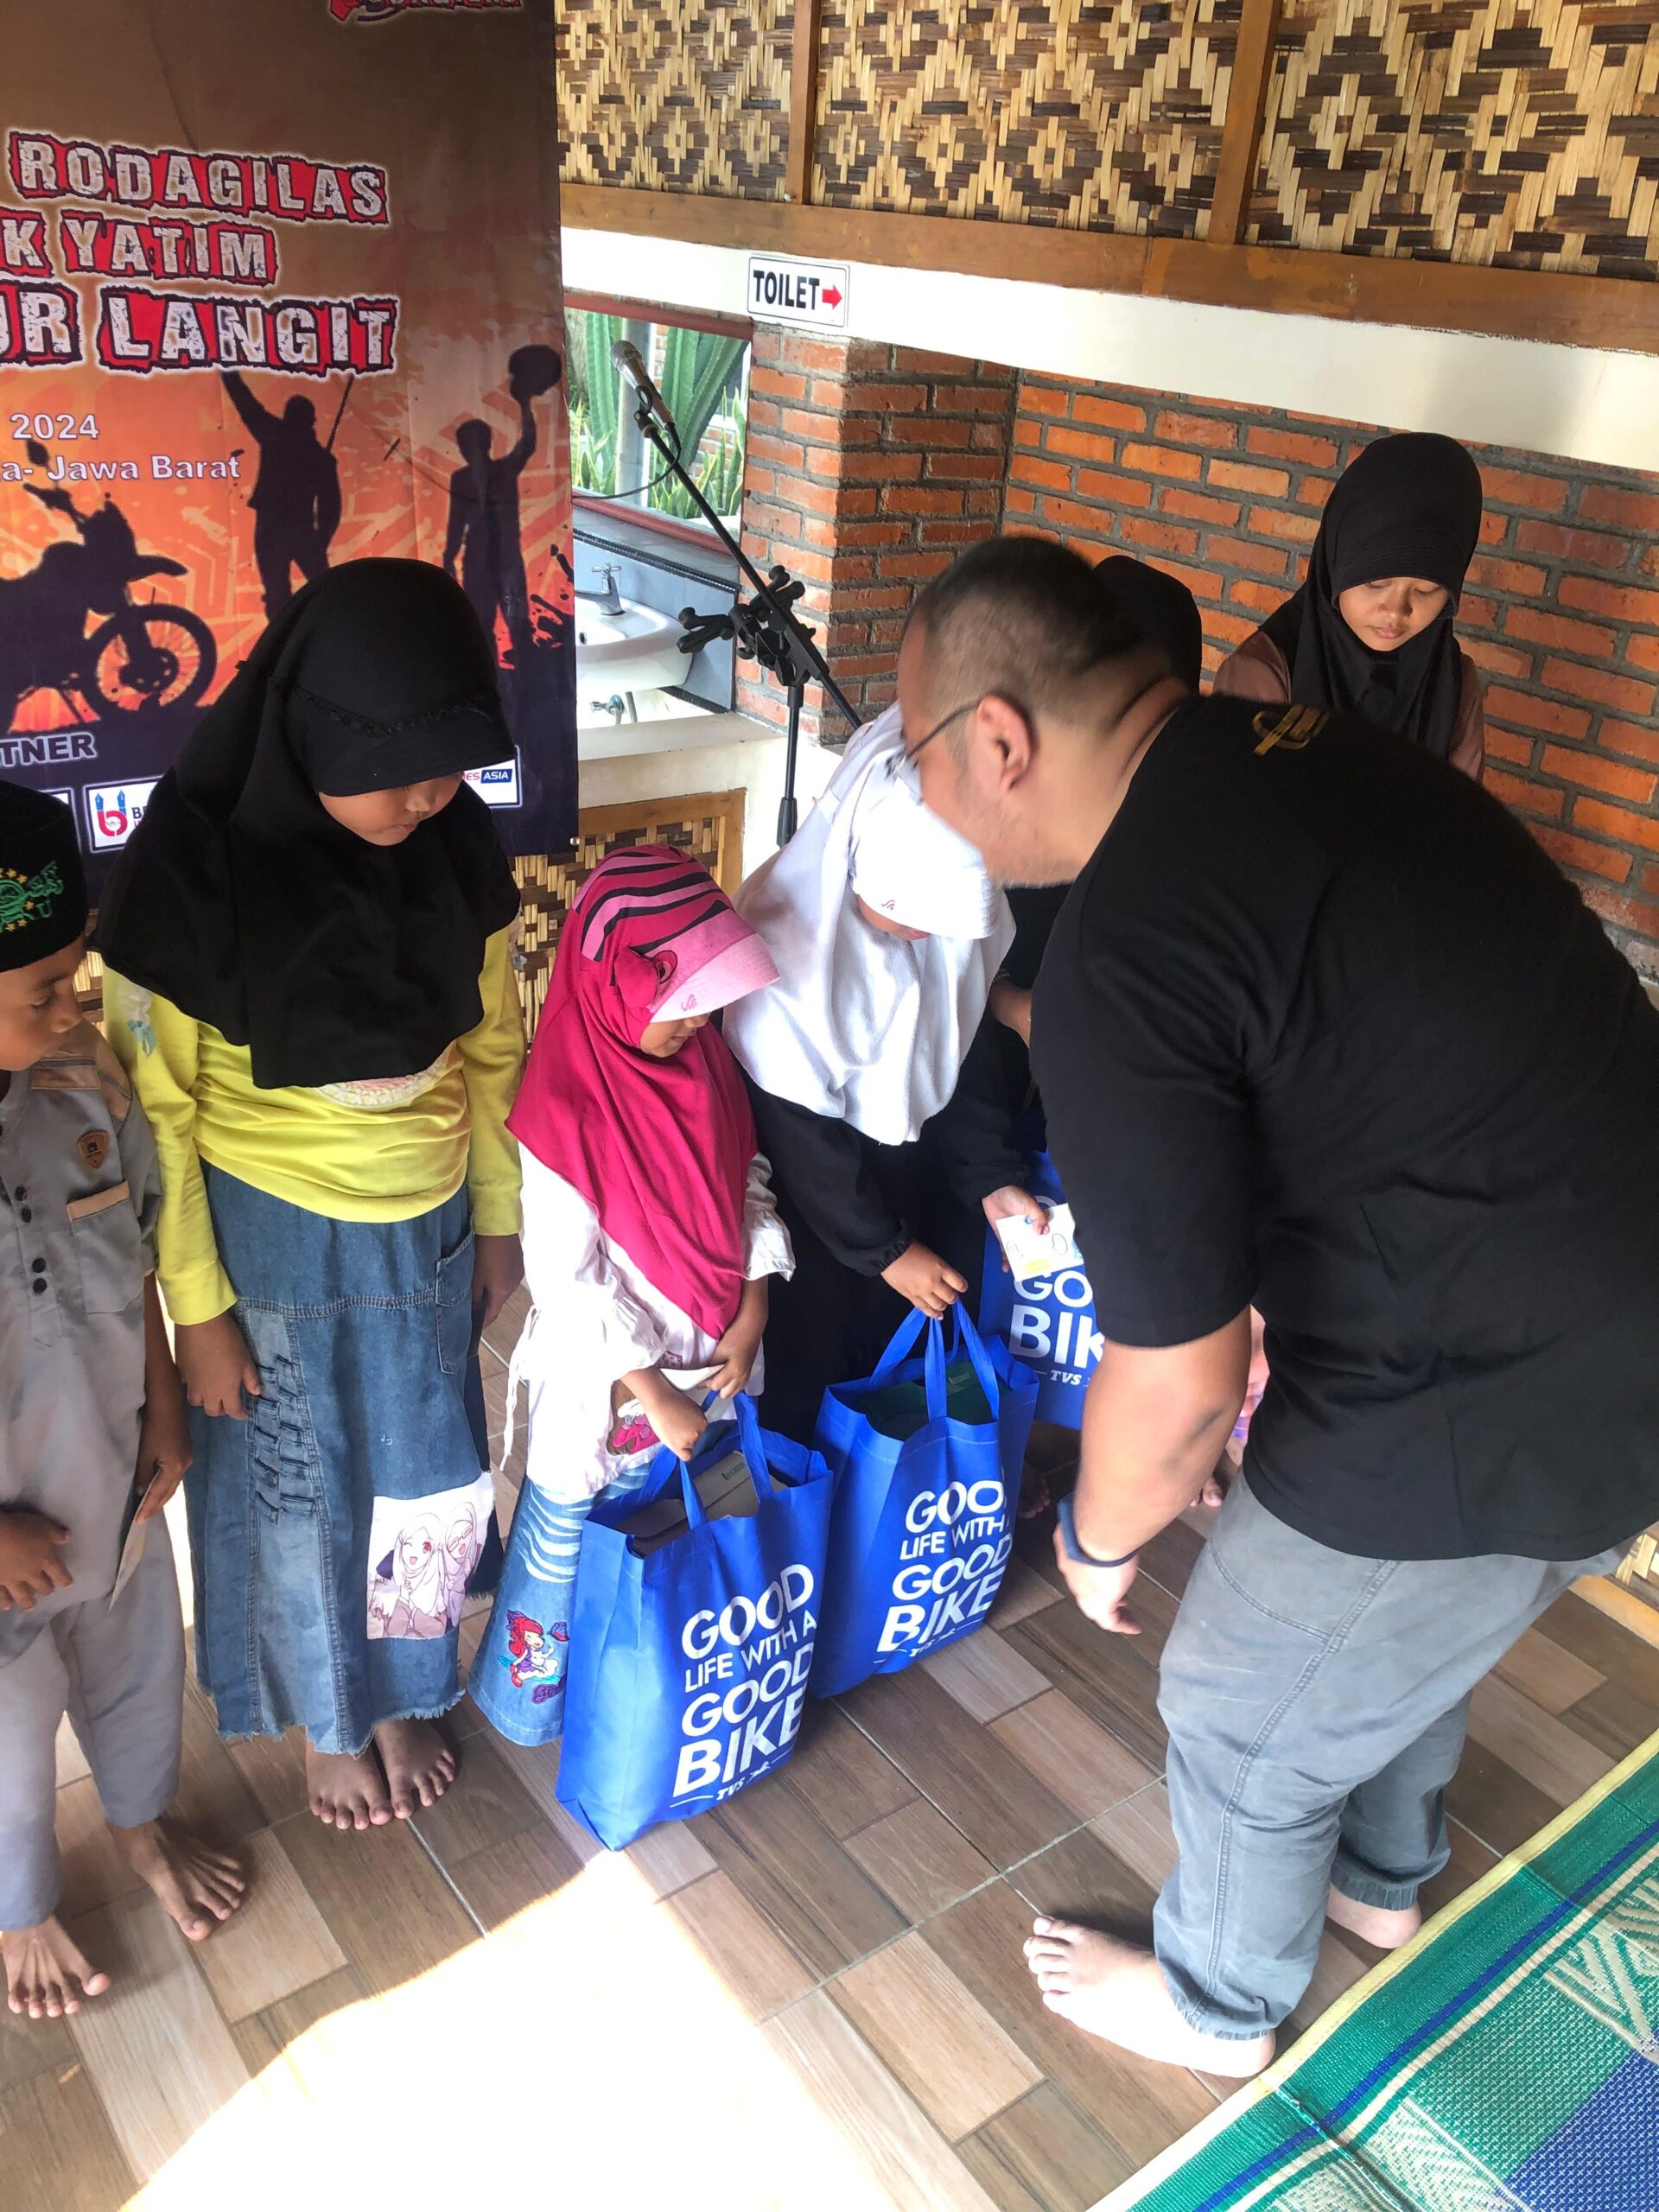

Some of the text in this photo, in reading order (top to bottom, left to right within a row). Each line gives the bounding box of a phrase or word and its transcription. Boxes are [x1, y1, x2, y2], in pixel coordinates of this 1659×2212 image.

[17, 139, 383, 217] RODAGILAS
[63, 218, 268, 279] YATIM
[753, 270, 820, 310] TOILET
[107, 296, 391, 365] LANGIT
[10, 413, 99, 439] 2024
[47, 455, 138, 480] Jawa
[151, 454, 241, 480] Barat
[0, 734, 96, 766] TNER
[463, 771, 509, 781] ES ASIA
[1014, 1270, 1093, 1307] GO
[1008, 1304, 1105, 1369] BIK
[1051, 1370, 1082, 1385] TVS
[905, 1480, 1006, 1534] GOO
[899, 1514, 1005, 1560] LIFE WITH
[892, 1533, 1013, 1600] GOOD
[682, 1564, 814, 1660] GOOD
[876, 1565, 1006, 1652] BIKE
[685, 1609, 817, 1694] LIFE WITH A
[682, 1642, 814, 1737] GOOD
[672, 1679, 808, 1798] BIKE
[715, 1775, 746, 1801] TVS
